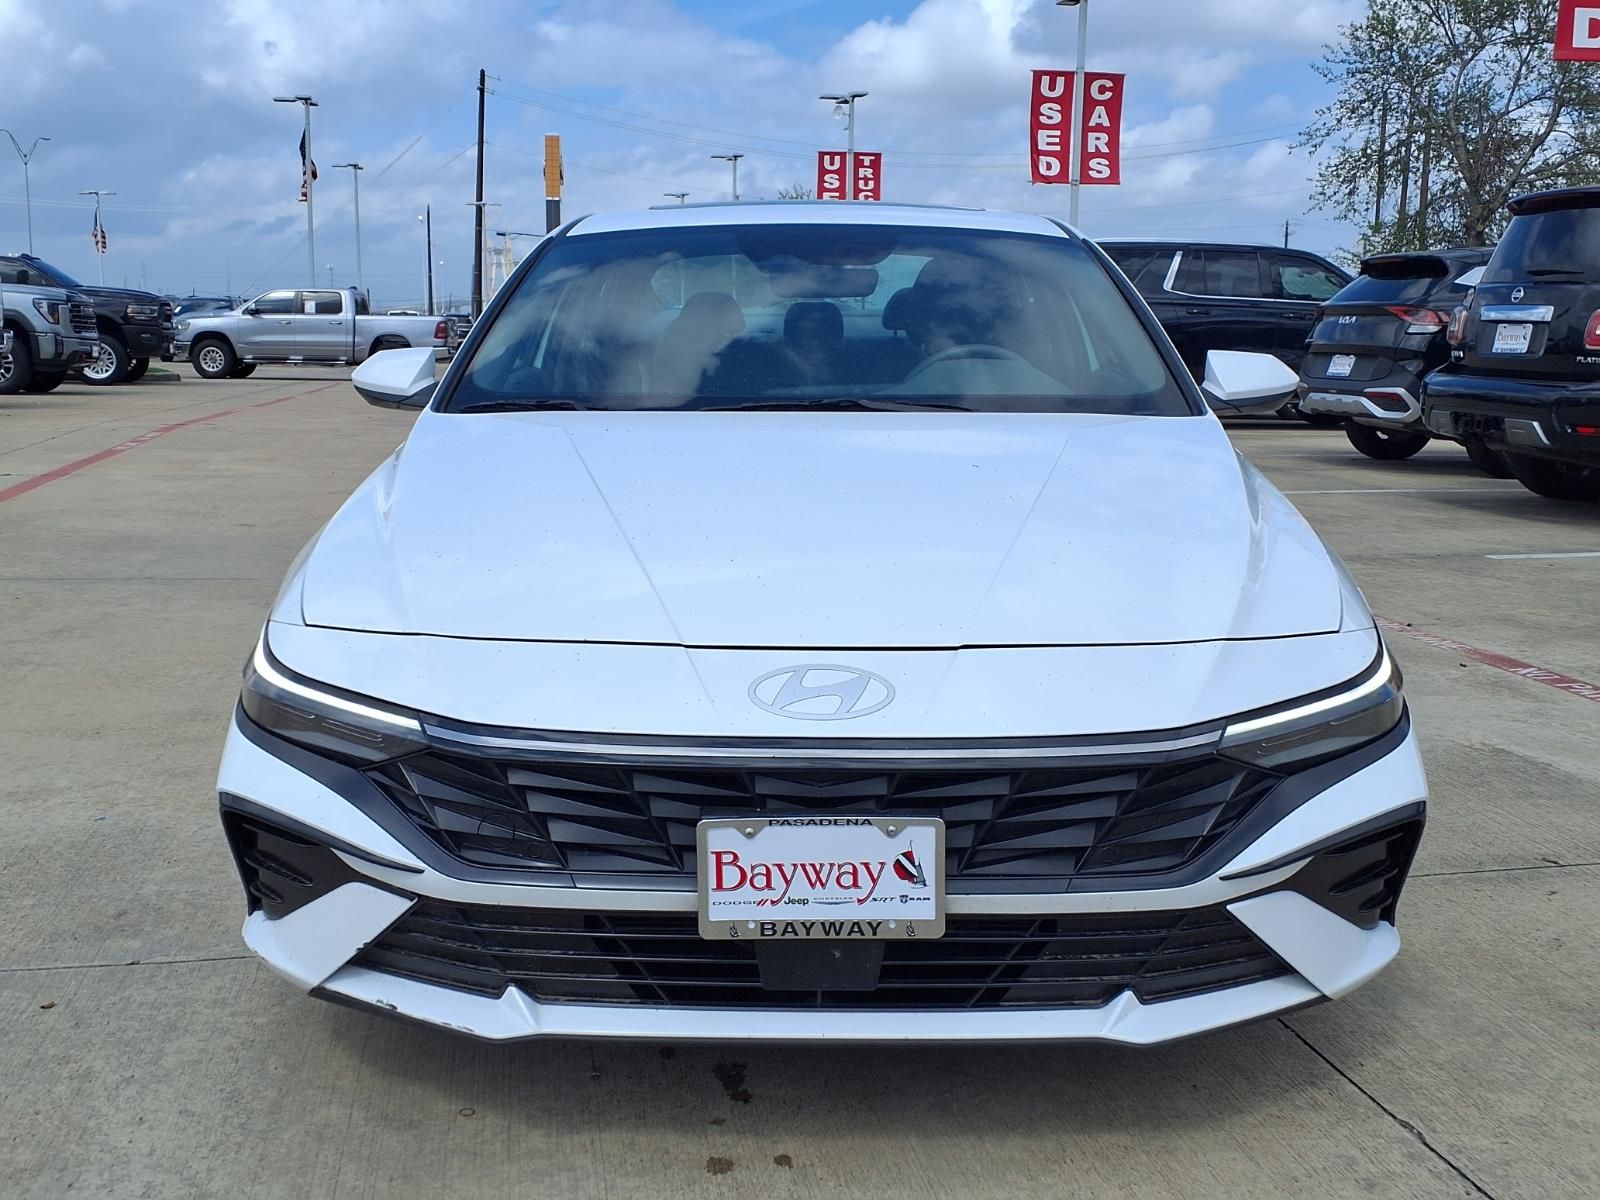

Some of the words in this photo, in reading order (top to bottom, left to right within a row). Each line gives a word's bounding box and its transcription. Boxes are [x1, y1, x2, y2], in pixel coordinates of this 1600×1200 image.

[1037, 75, 1065, 177] USED
[1088, 79, 1114, 179] CARS
[822, 155, 841, 200] USE
[858, 156, 876, 200] TRUC
[711, 851, 887, 906] Bayway
[784, 896, 809, 906] Jeep
[760, 921, 883, 937] BAYWAY
